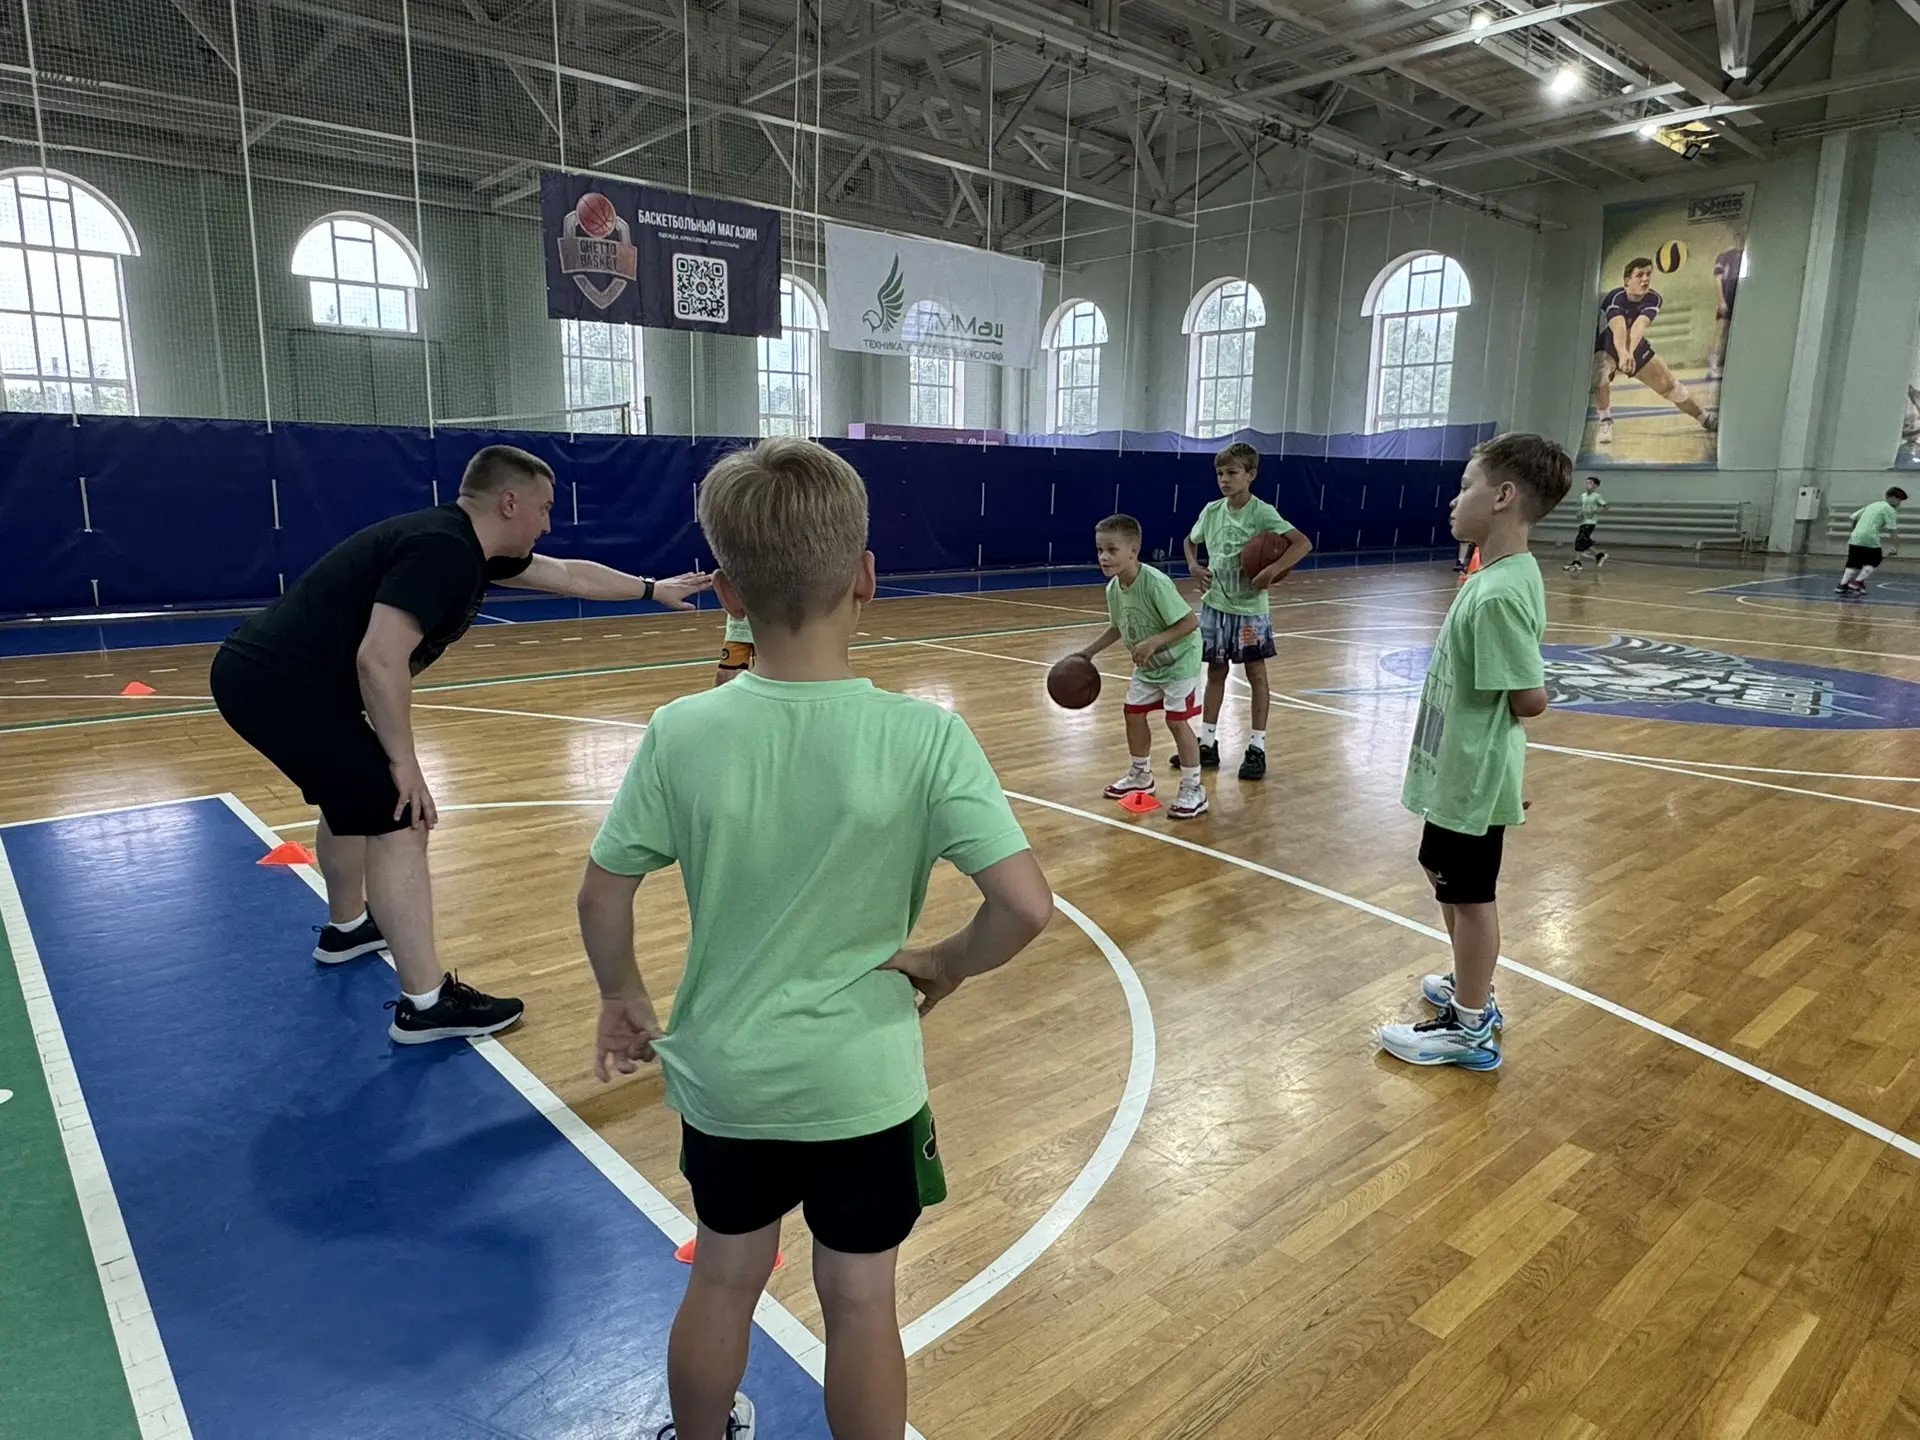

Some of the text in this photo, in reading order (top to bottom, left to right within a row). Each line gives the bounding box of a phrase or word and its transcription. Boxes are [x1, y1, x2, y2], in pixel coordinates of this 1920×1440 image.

[638, 209, 758, 242] БАСКЕТБОЛЬНЫЙ МАГАЗИН
[580, 240, 617, 255] GHETTO
[580, 254, 618, 271] BASKET
[863, 338, 903, 352] ТЕХНИКА
